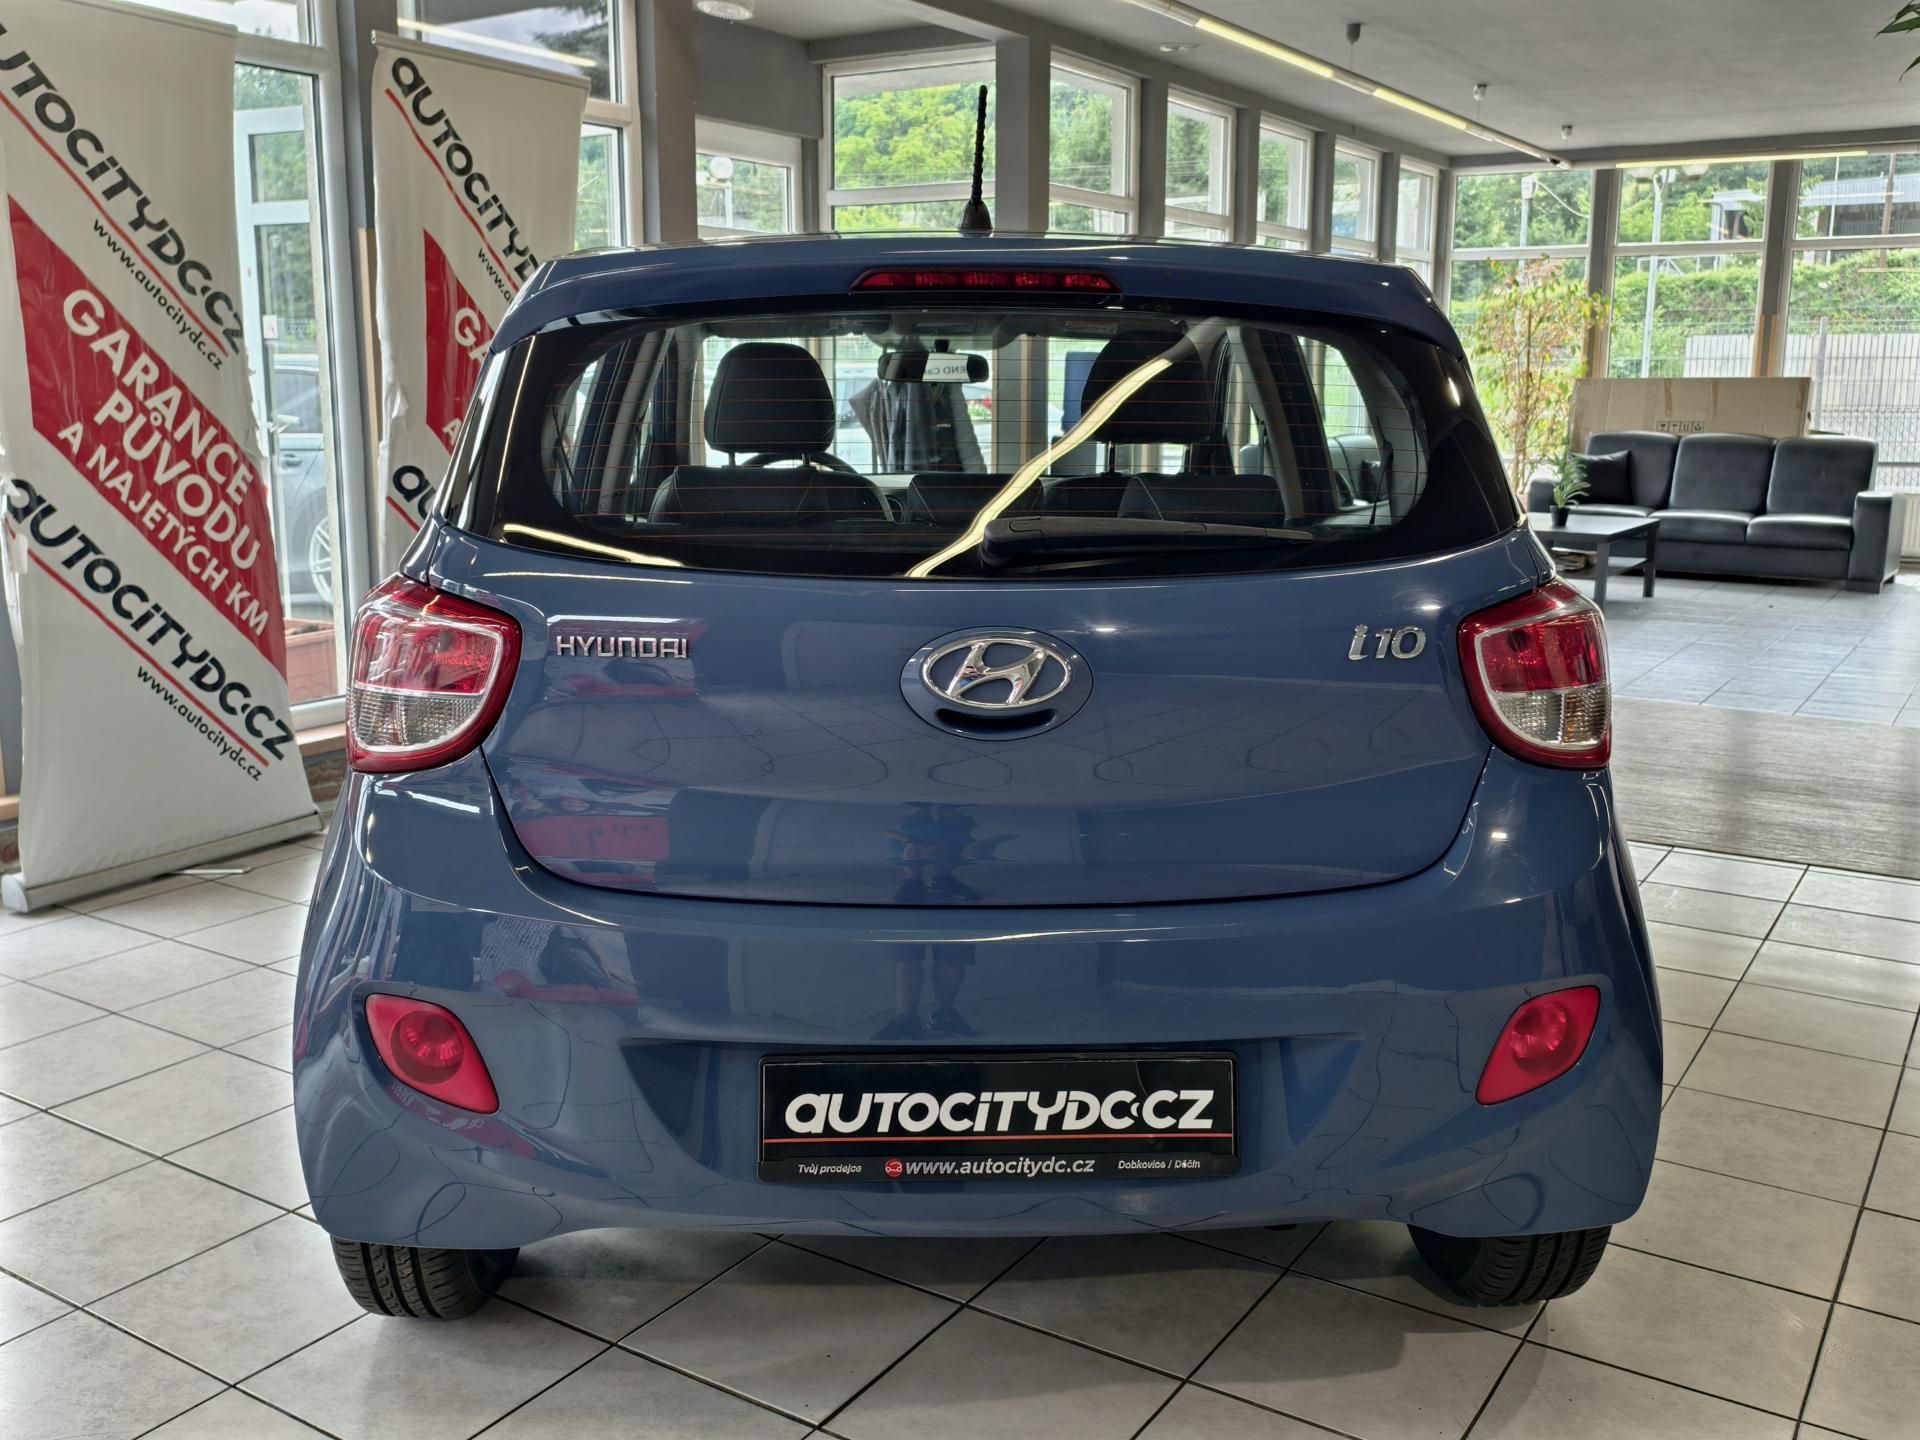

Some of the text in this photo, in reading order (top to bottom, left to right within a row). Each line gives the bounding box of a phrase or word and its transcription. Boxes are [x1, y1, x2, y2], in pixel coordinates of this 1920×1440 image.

[93, 218, 223, 370] www.autocitydc.cz
[478, 247, 514, 305] www.a
[64, 289, 253, 505] GARANCE
[93, 389, 261, 569] PŮVODU
[57, 422, 270, 636] A NAJETÝCH KM
[556, 635, 688, 659] HYUNDAI
[1348, 624, 1427, 661] i10
[137, 665, 263, 782] www.autocitydc.cz
[798, 1163, 862, 1175] Tvůj prodejce
[905, 1156, 1095, 1177] www.autocitydc.cz
